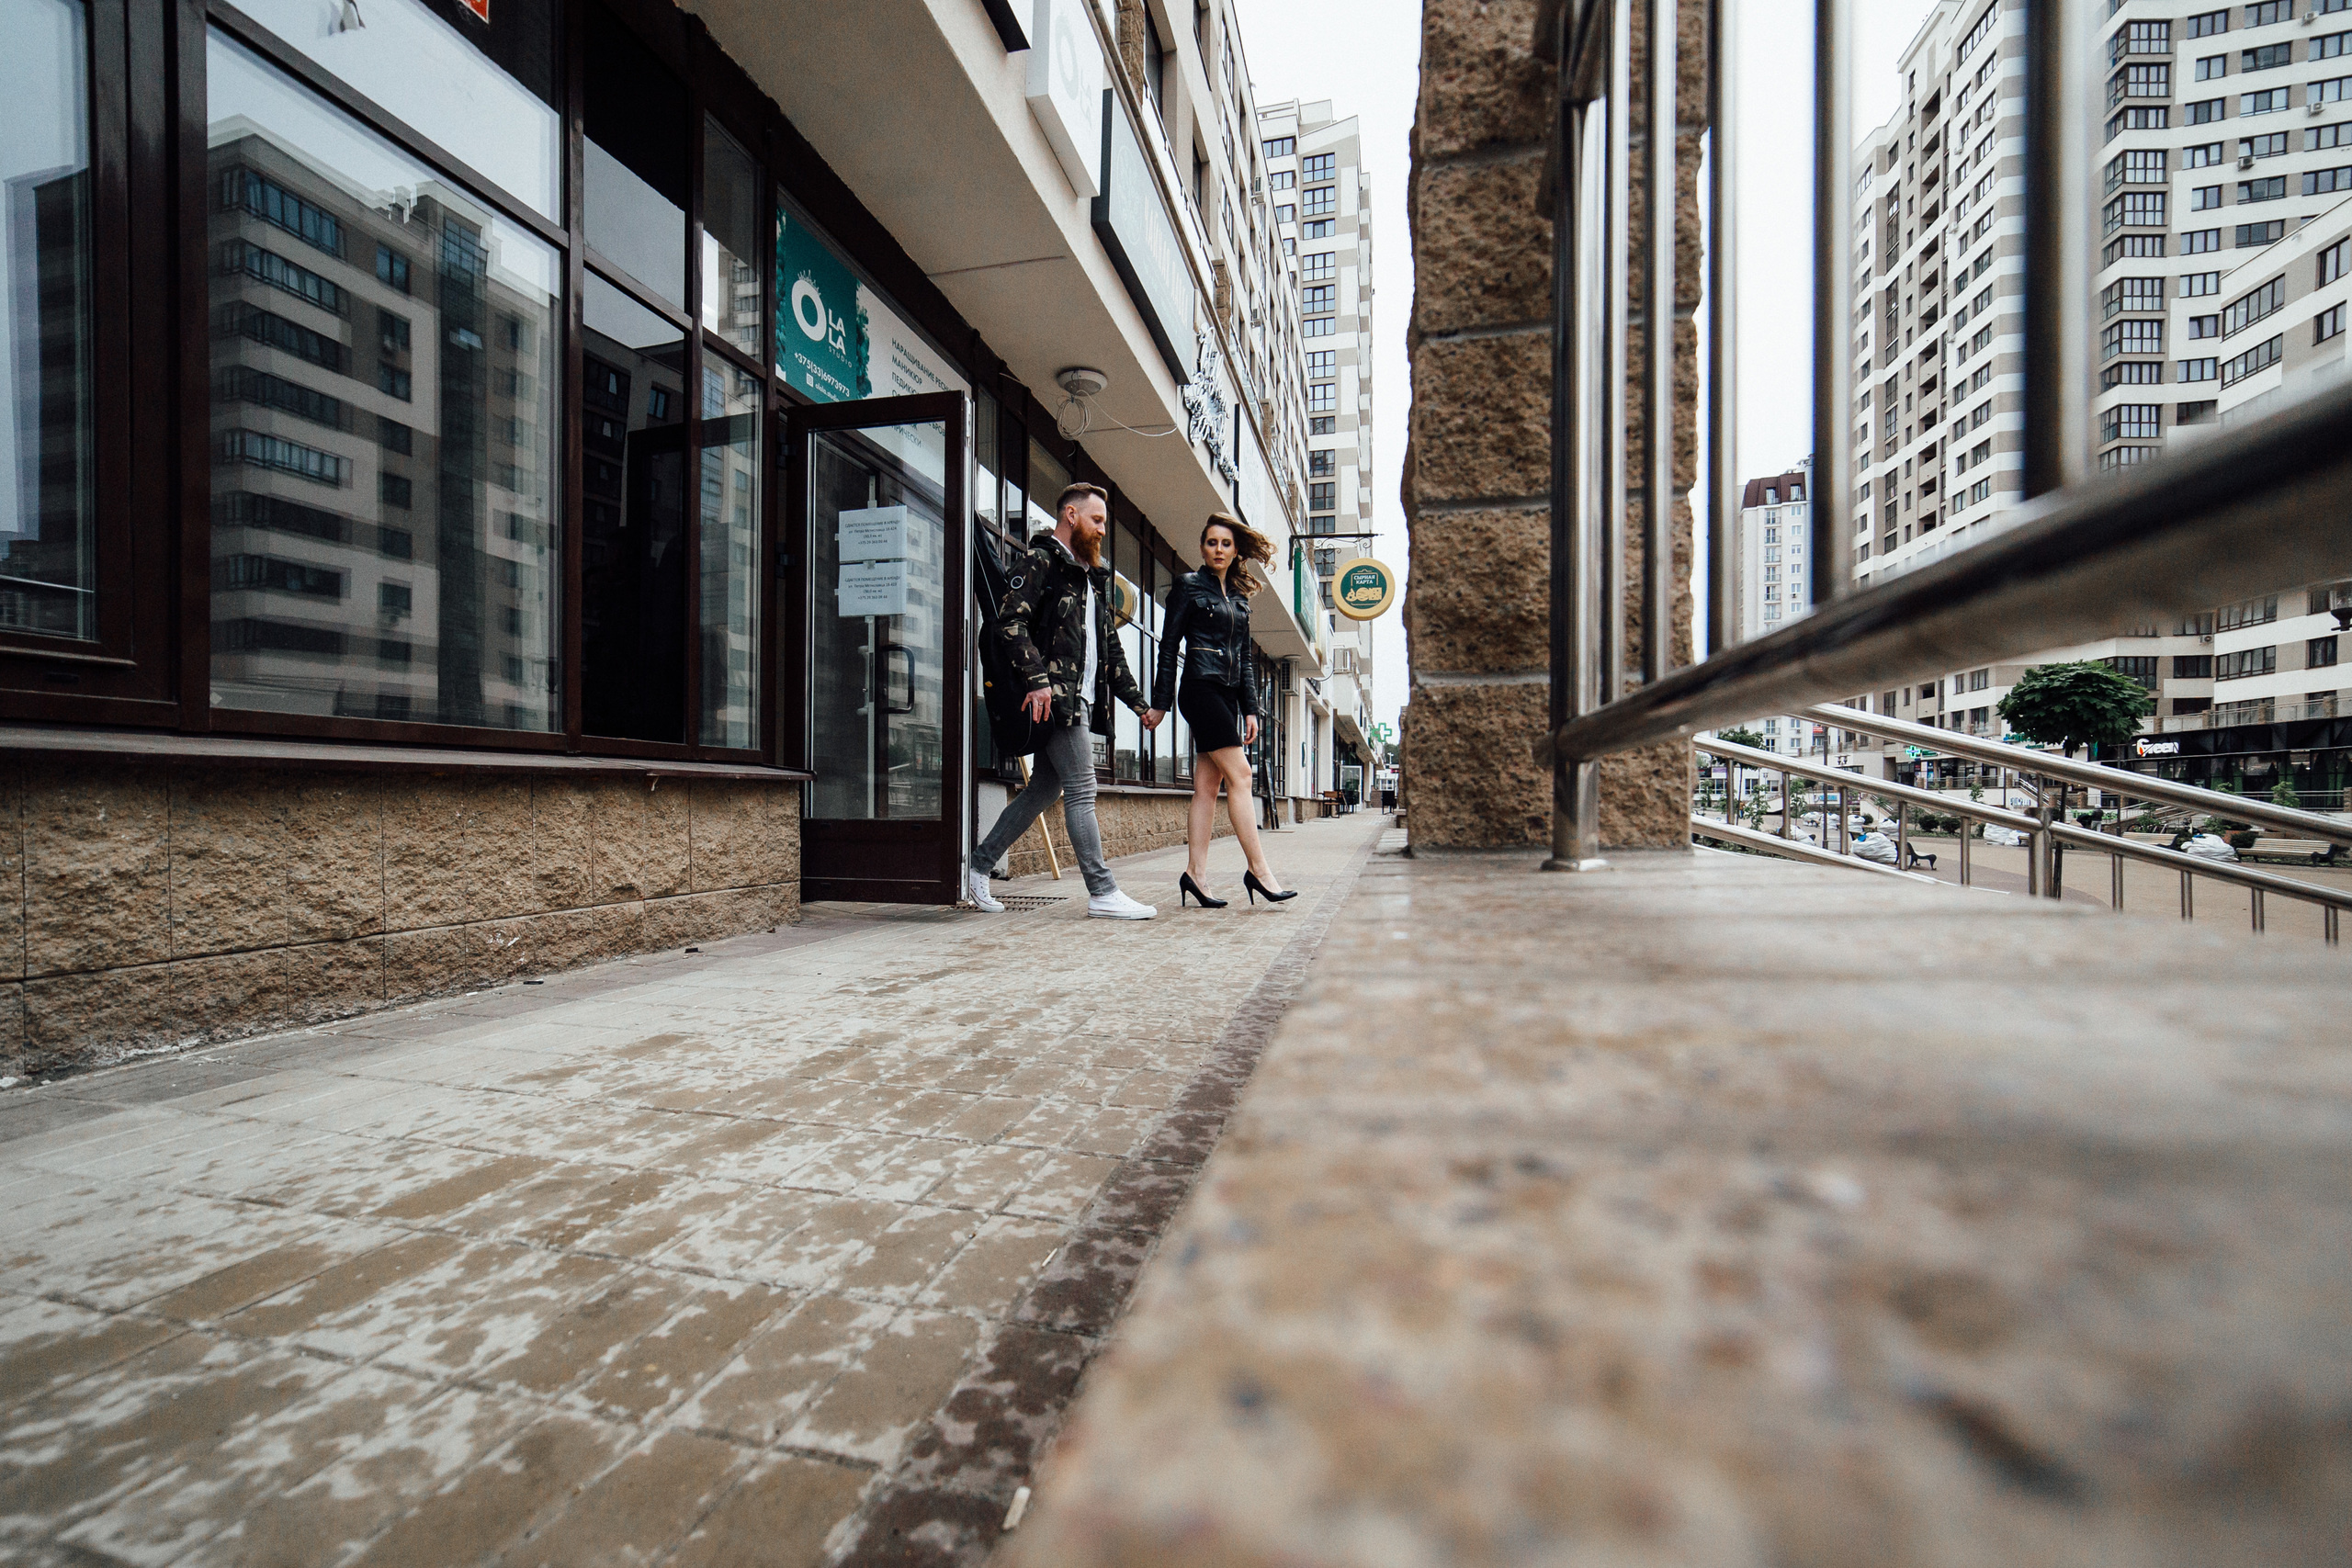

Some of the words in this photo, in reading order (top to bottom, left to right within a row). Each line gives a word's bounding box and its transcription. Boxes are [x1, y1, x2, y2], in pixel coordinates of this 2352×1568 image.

[829, 308, 846, 337] LA
[829, 326, 846, 355] LA
[829, 346, 853, 368] STUDIO
[891, 337, 935, 382] НАРАЩИВАНИЕ
[891, 354, 922, 386] МАНИКЮР
[794, 352, 850, 397] +375(33)6973973
[2136, 738, 2179, 757] Green
